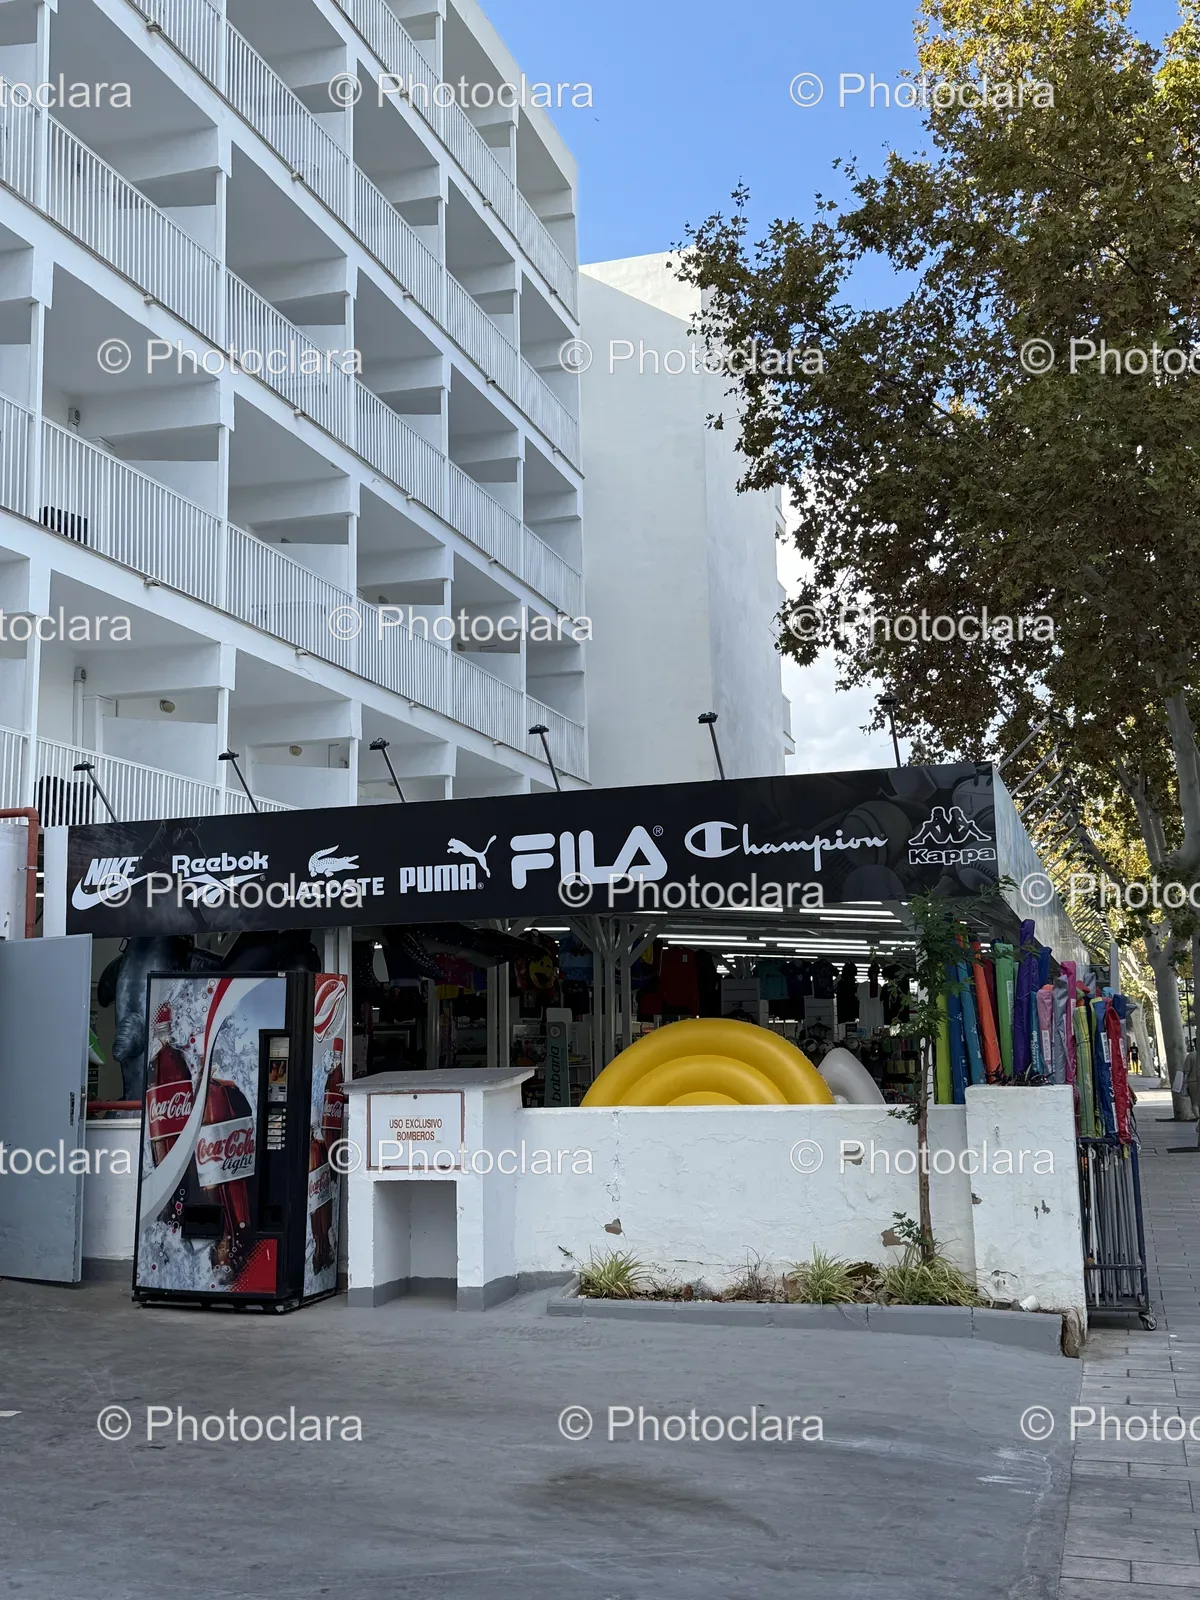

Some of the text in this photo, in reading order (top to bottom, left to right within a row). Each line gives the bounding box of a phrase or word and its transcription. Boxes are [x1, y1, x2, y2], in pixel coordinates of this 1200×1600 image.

[510, 825, 668, 889] FILA
[684, 820, 886, 872] Champion
[908, 846, 996, 866] Kappa
[84, 856, 140, 886] NIKE
[171, 851, 269, 878] Reebok
[399, 863, 477, 894] PUMA
[284, 876, 385, 901] LACOSTE
[550, 1045, 562, 1102] babaria
[150, 1091, 193, 1124] Coca-Cola
[389, 1118, 443, 1129] USO EXCLUSIVO
[396, 1131, 435, 1141] BOMBEROS
[197, 1127, 256, 1165] Coca-Cola
[222, 1153, 254, 1175] light
